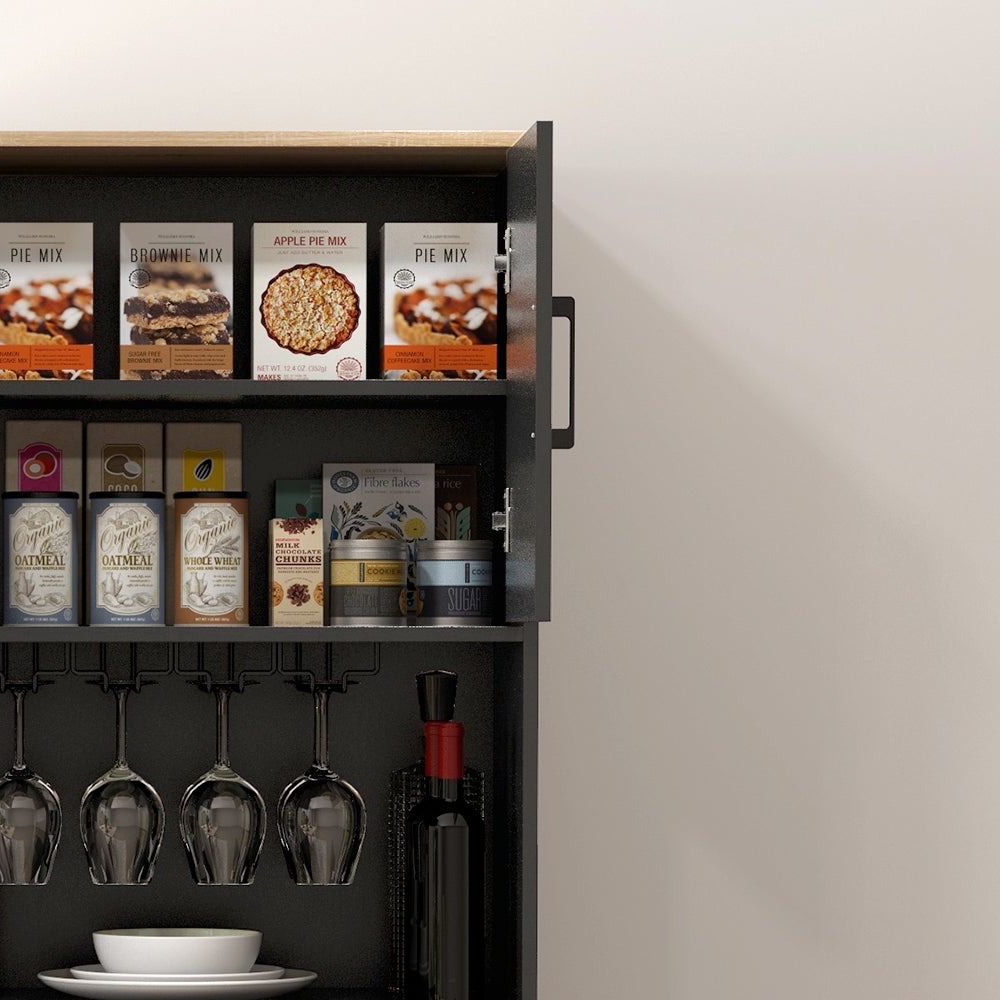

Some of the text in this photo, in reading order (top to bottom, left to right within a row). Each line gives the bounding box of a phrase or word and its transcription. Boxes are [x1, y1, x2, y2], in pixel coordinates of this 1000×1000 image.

[273, 236, 347, 246] APPLE PIE MIX
[10, 248, 63, 263] PIE MIX
[130, 248, 223, 263] BROWNIE MIX
[415, 248, 467, 263] PIE MIX
[364, 477, 389, 488] Fibre
[391, 477, 421, 488] flakes
[442, 478, 462, 489] rice
[12, 516, 64, 553] Organic
[100, 516, 152, 553] Organic
[184, 516, 237, 553] Organic
[14, 554, 66, 566] OATMEAL
[101, 555, 153, 566] OATMEAL
[184, 556, 242, 565] WHOLE WHEAT
[275, 555, 322, 563] CHUNKS
[447, 587, 482, 611] SUGAR
